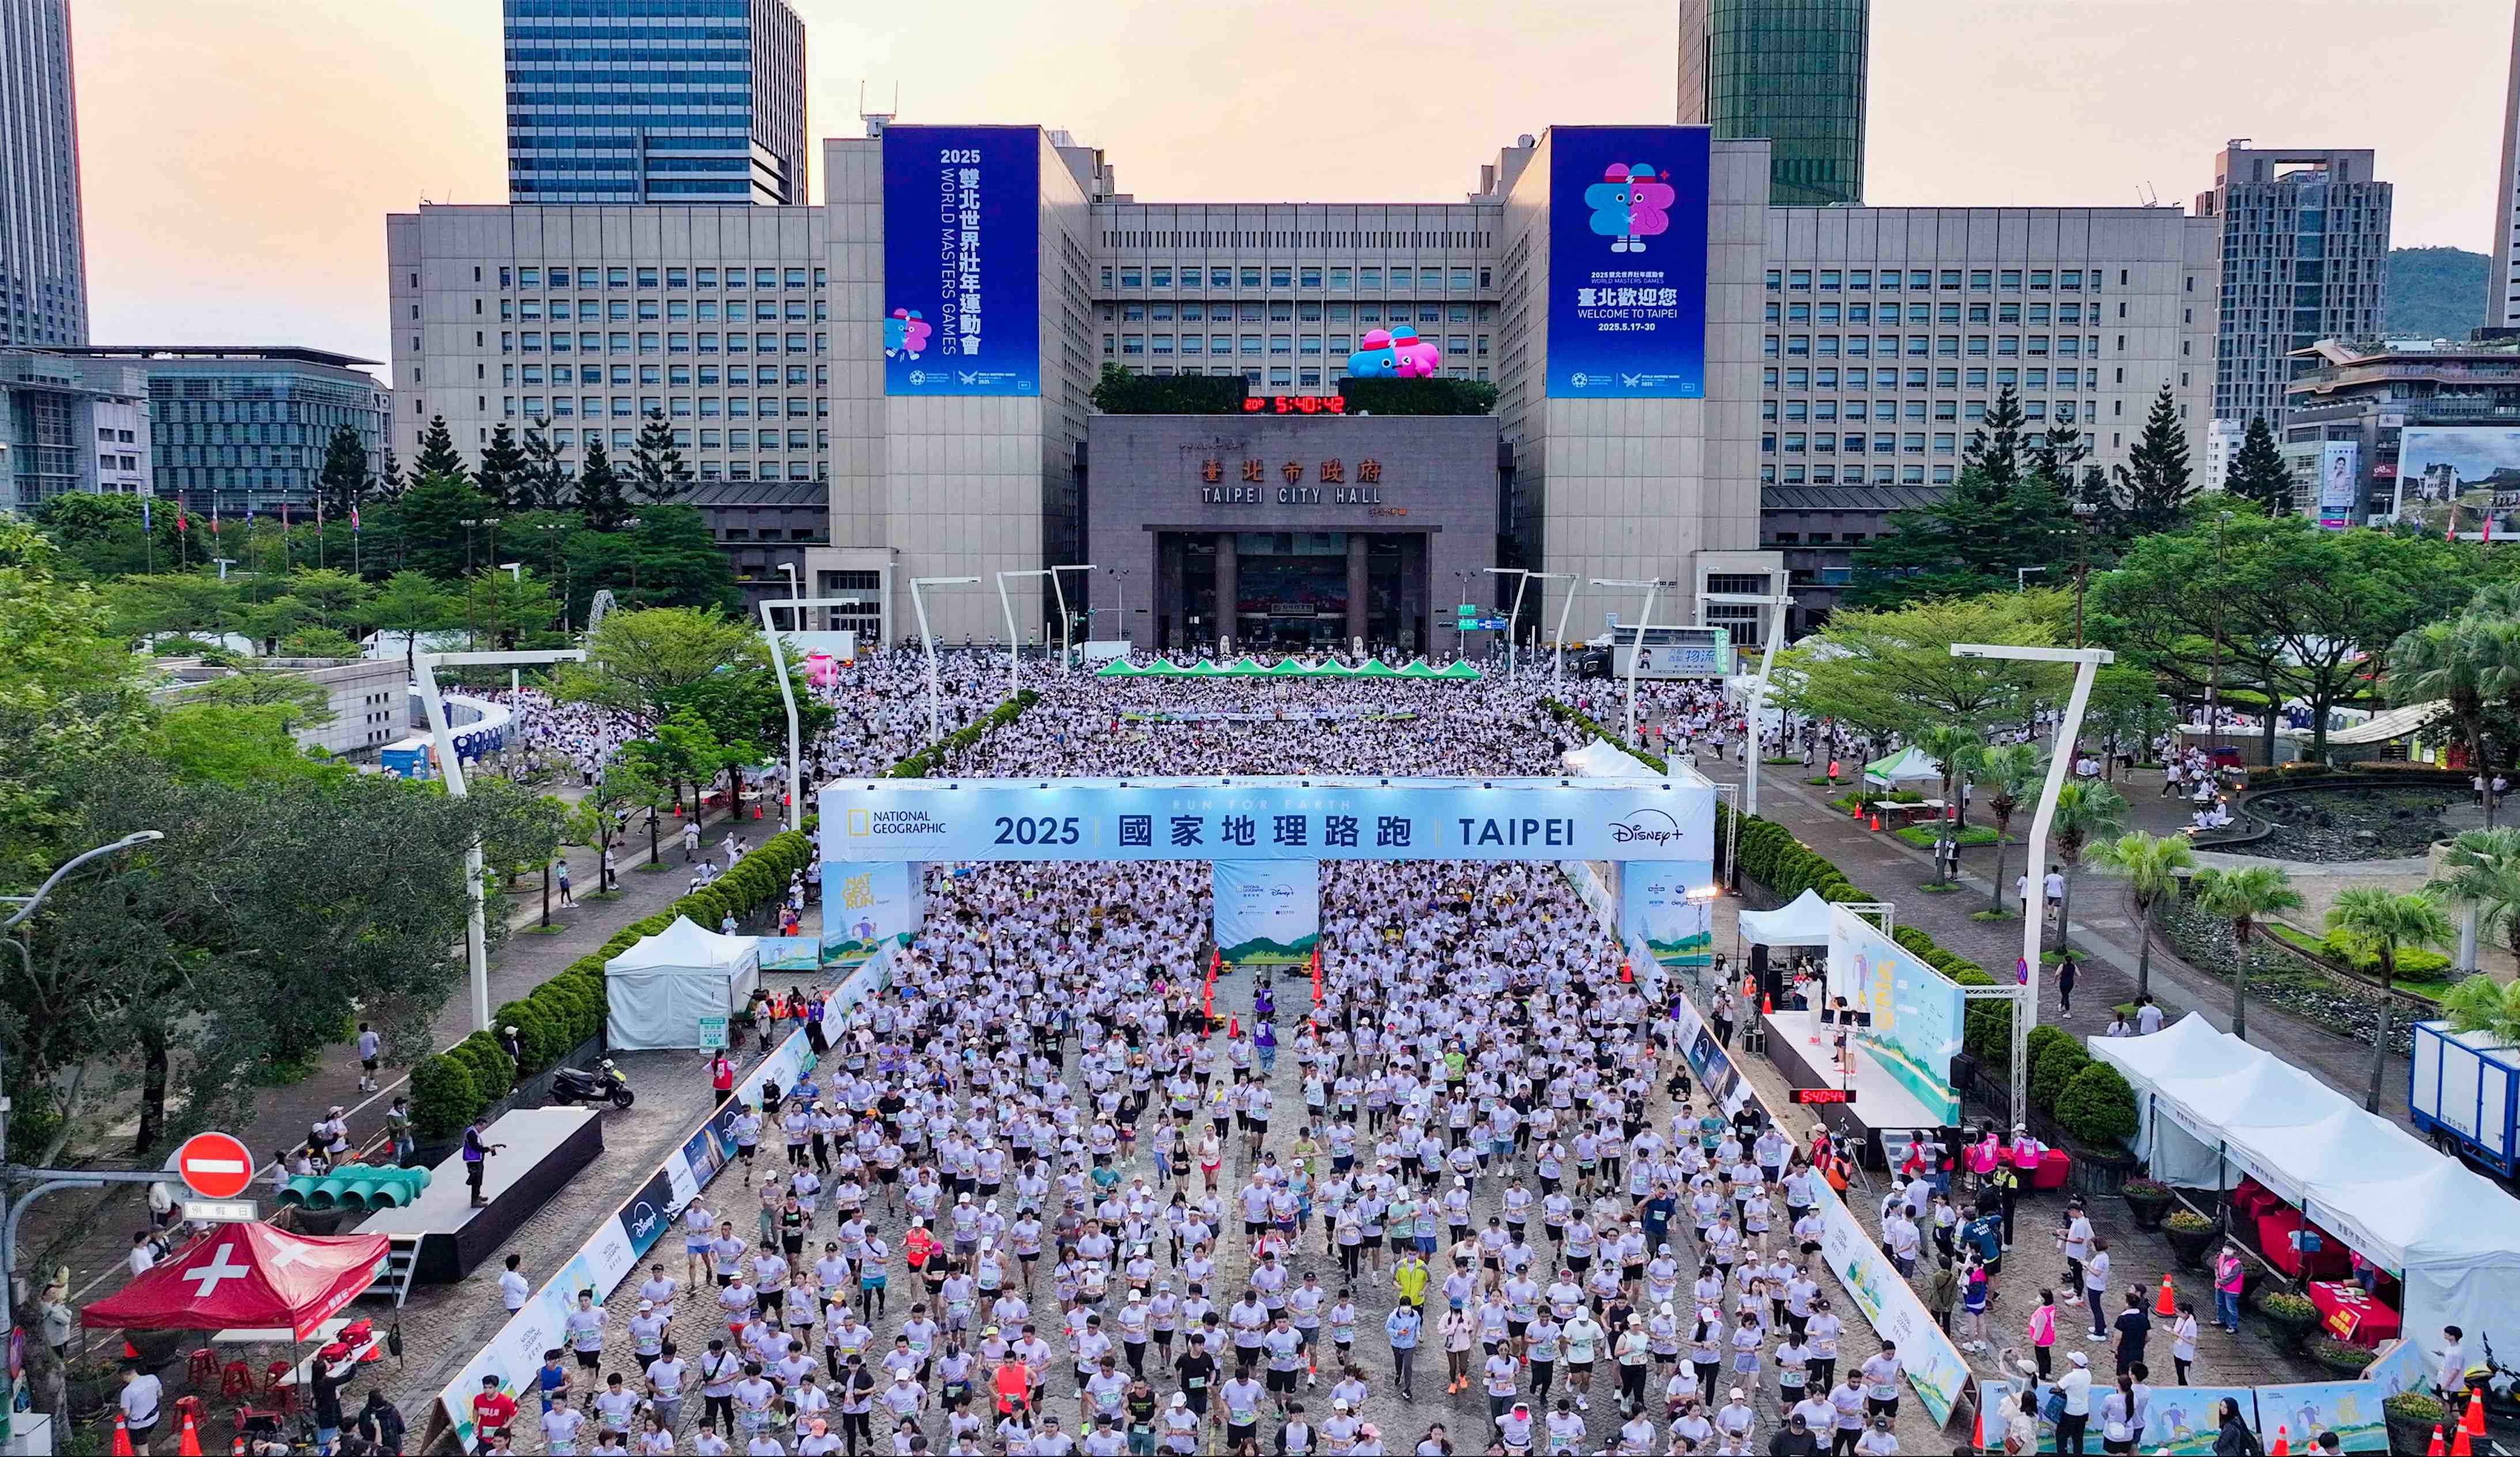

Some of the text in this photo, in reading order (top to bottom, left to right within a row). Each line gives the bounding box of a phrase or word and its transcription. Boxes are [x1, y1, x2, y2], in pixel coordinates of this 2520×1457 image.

[940, 149, 980, 164] 2025
[941, 168, 957, 355] WORLD MASTERS GAMES
[958, 168, 981, 355] 雙北世界壯年運動會
[1577, 287, 1678, 306] 臺北歡迎您
[1578, 309, 1678, 318] WELCOME TO TAIPEI
[1598, 323, 1656, 331] 2025.5.17-30
[1276, 397, 1344, 413] 5:40:42
[1202, 458, 1382, 484] 臺北市政府
[1203, 487, 1381, 503] TAIPEI CITY HALL
[1173, 800, 1351, 810] RUN FOR EARTH
[874, 811, 931, 822] NATIONAL
[873, 823, 947, 834] GEOGRAPHIC
[994, 816, 1080, 845] 2025
[1119, 814, 1412, 847] 國家地理路跑
[1459, 818, 1574, 846] TAIPEI
[844, 873, 874, 887] NAT
[845, 894, 875, 910] RUN
[1801, 1091, 1845, 1103] 5:40:44
